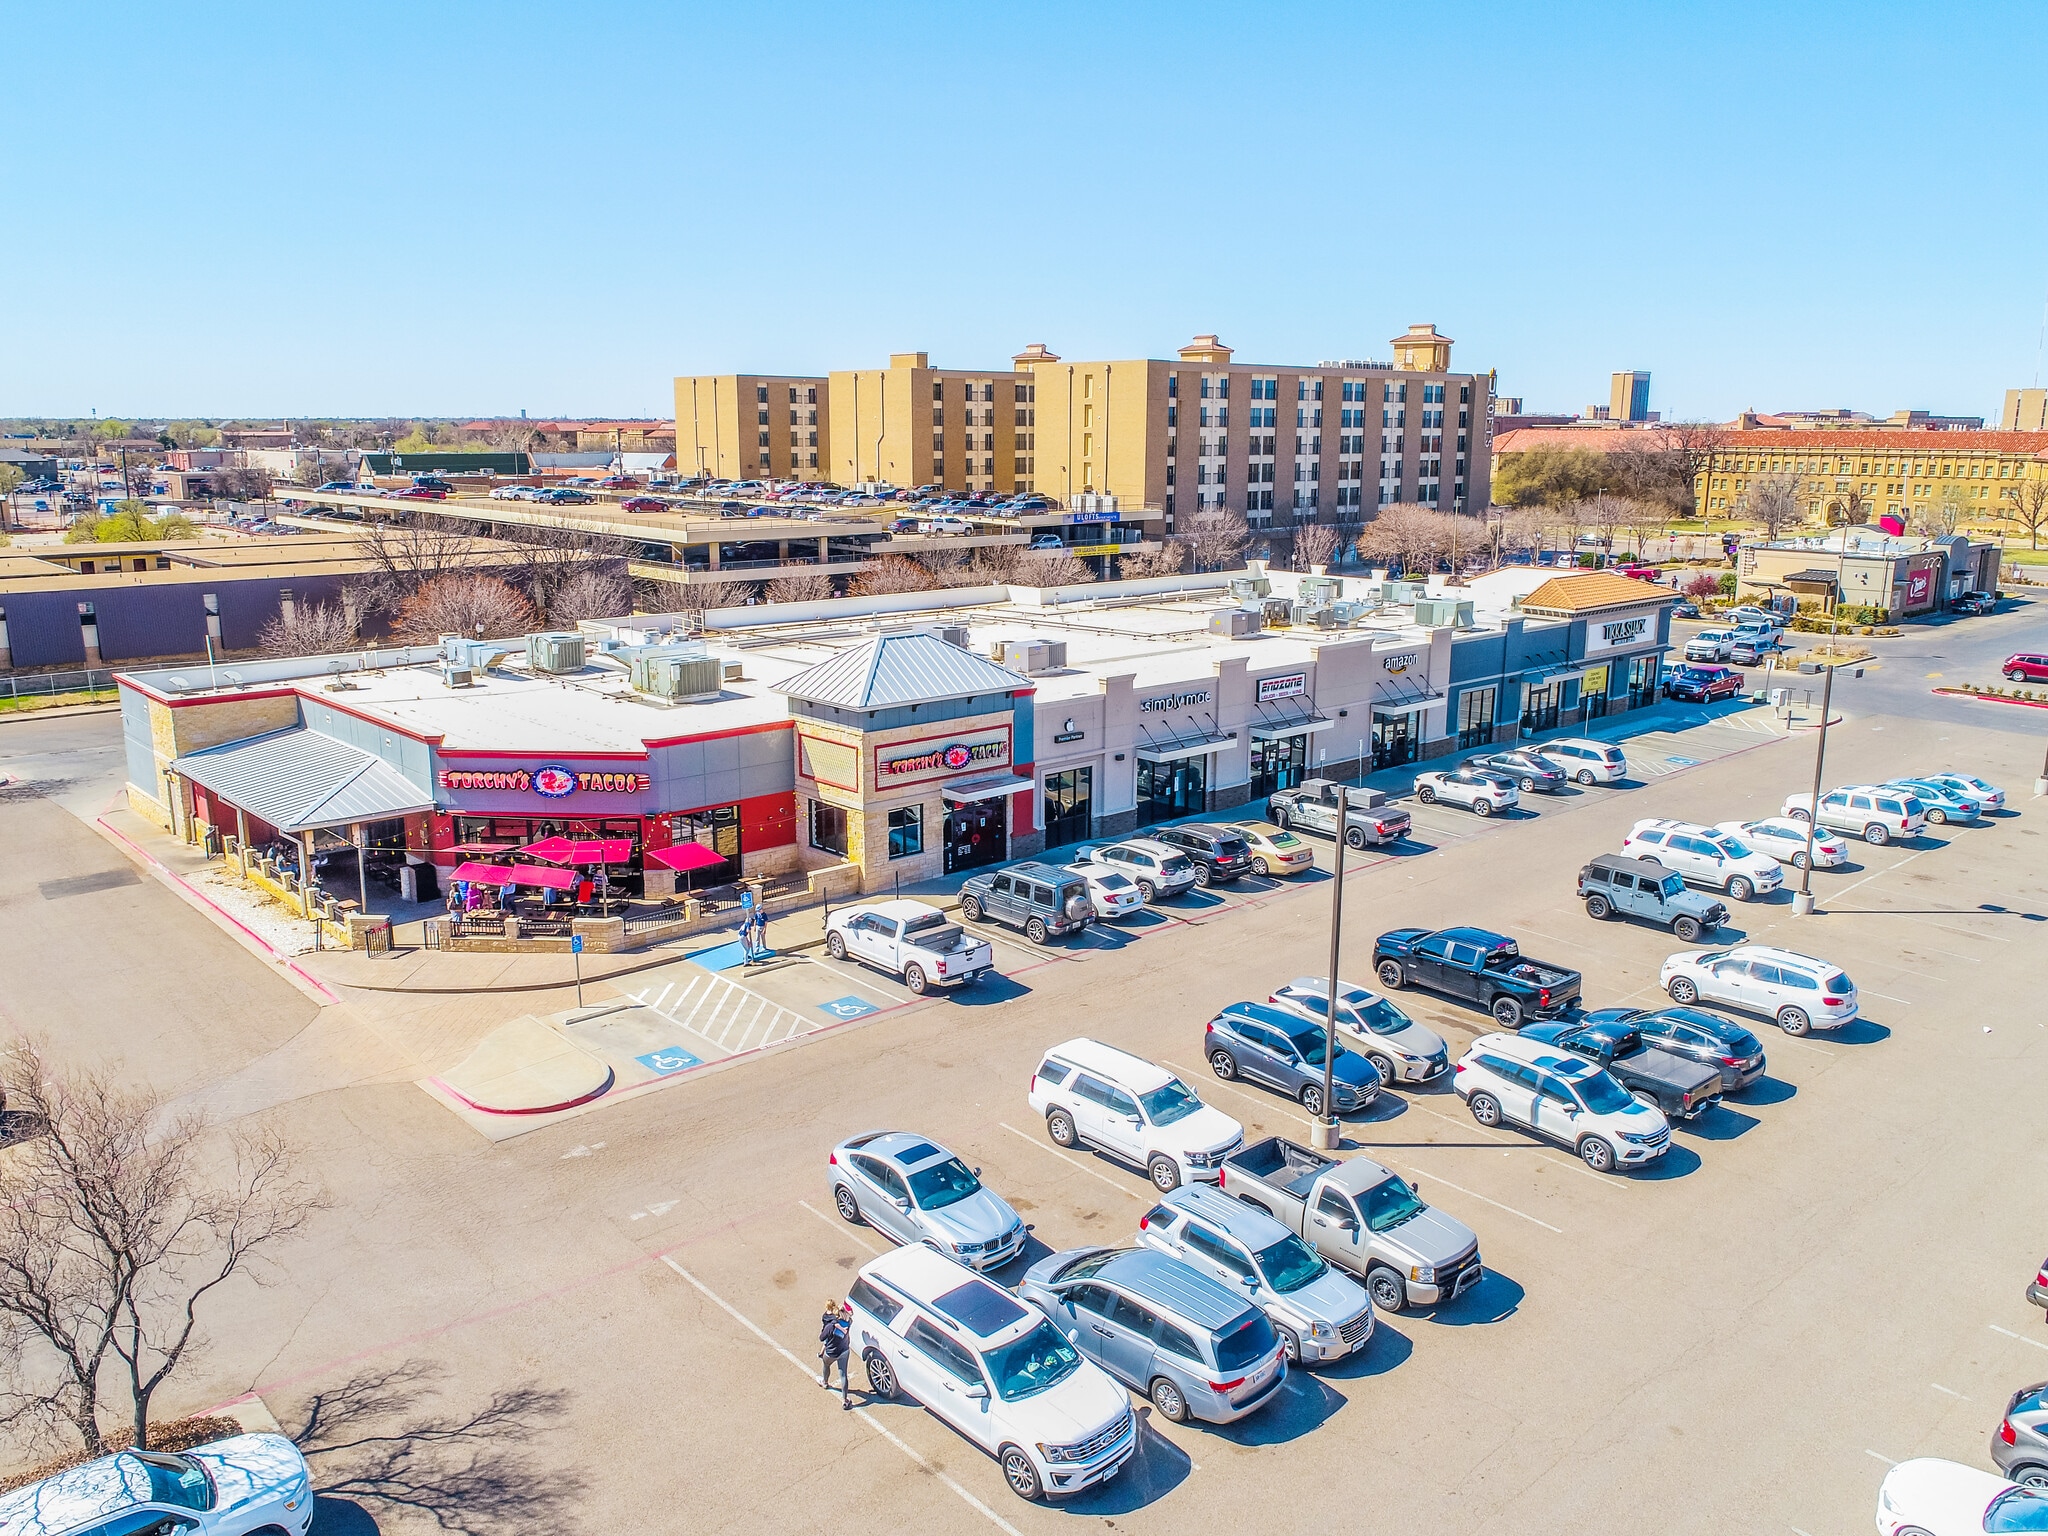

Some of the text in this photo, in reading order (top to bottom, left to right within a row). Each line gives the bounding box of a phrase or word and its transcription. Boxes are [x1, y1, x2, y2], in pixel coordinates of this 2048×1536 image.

[1384, 653, 1418, 669] amazon
[1261, 677, 1302, 692] ENDZONE
[1143, 691, 1212, 713] simply mac
[892, 743, 1007, 774] TORCHY'S TACOS
[448, 769, 638, 793] TORCHY'S TACOS
